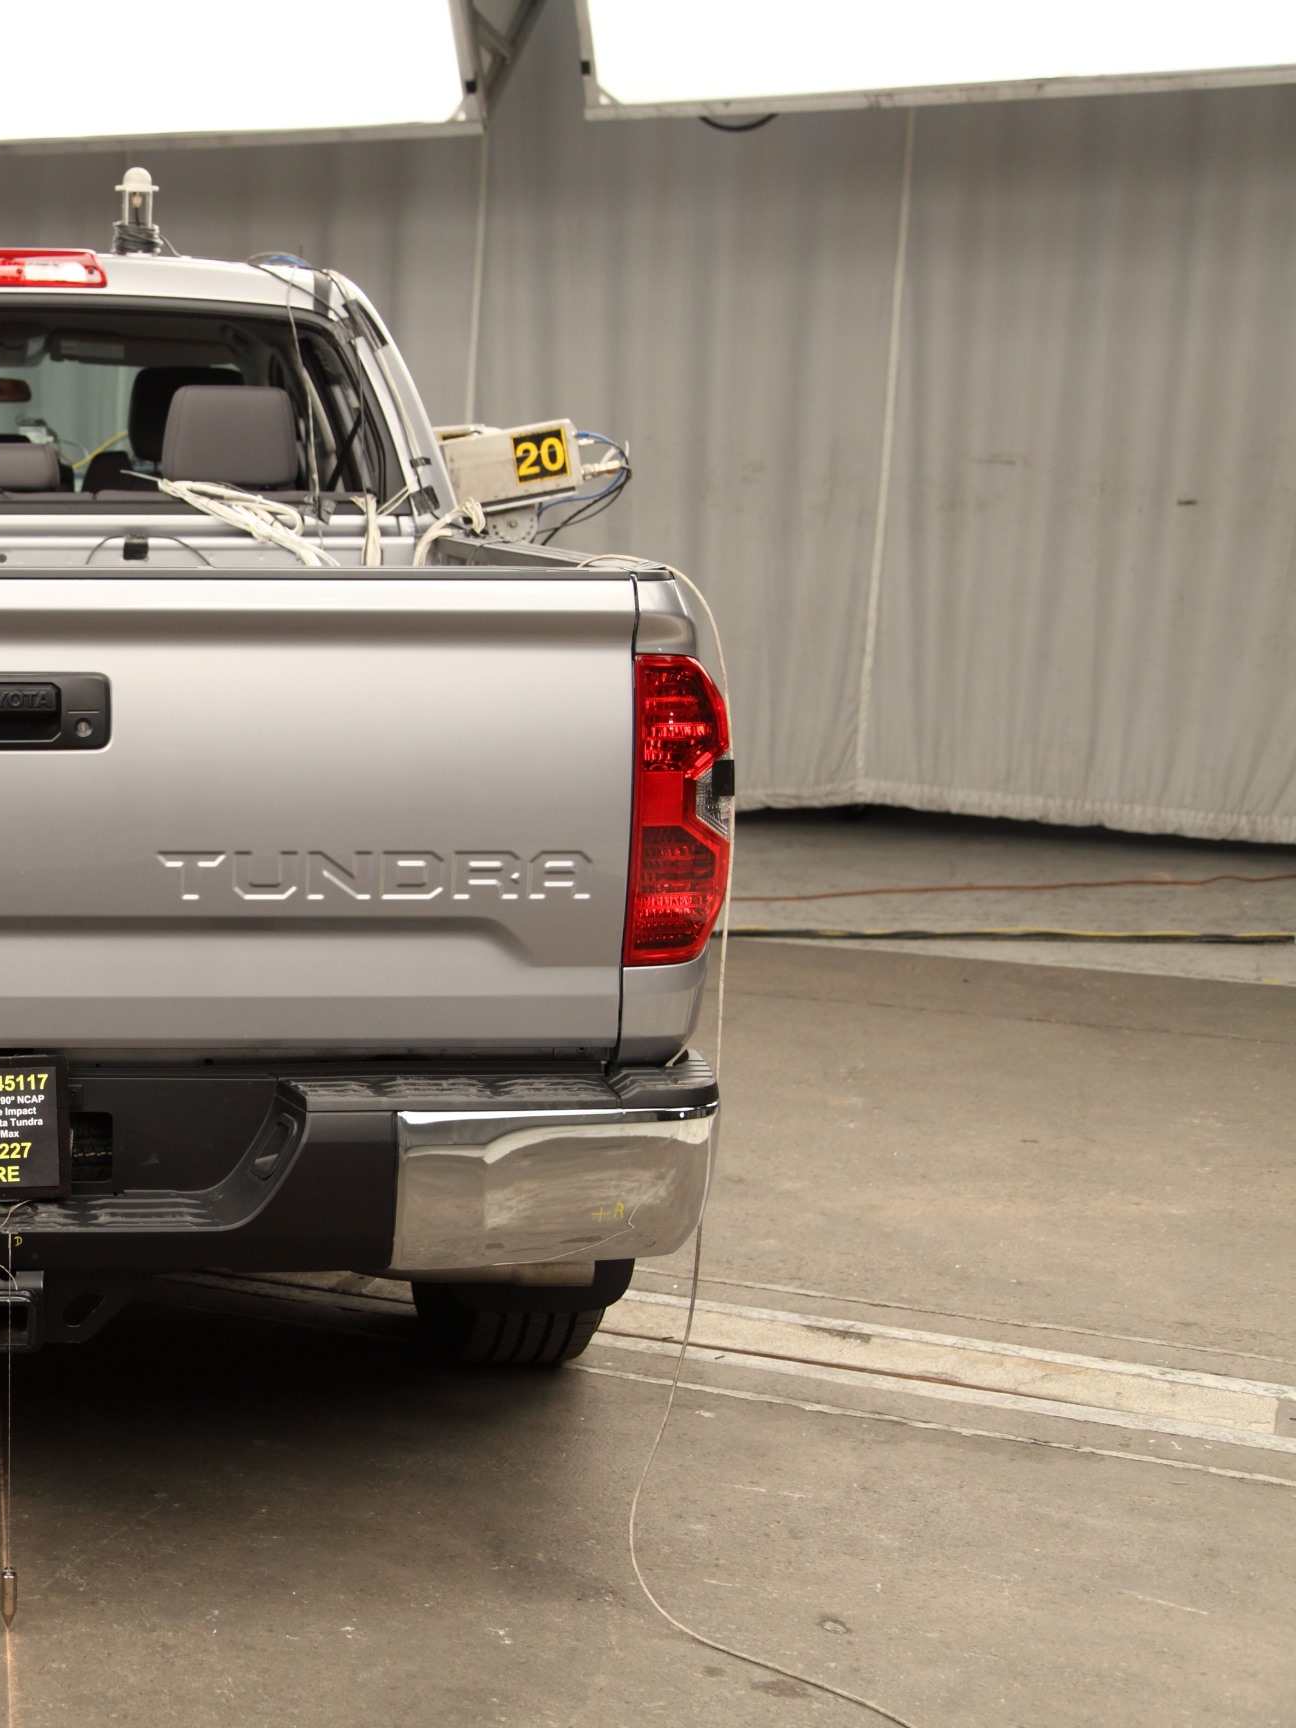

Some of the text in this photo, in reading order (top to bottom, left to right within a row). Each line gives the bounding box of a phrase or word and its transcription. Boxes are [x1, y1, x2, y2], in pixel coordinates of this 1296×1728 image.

[515, 437, 565, 477] 20
[157, 851, 593, 900] TUNDRA
[17, 1095, 45, 1104] NCAP
[5, 1107, 36, 1118] Impact
[10, 1118, 43, 1126] Tundra
